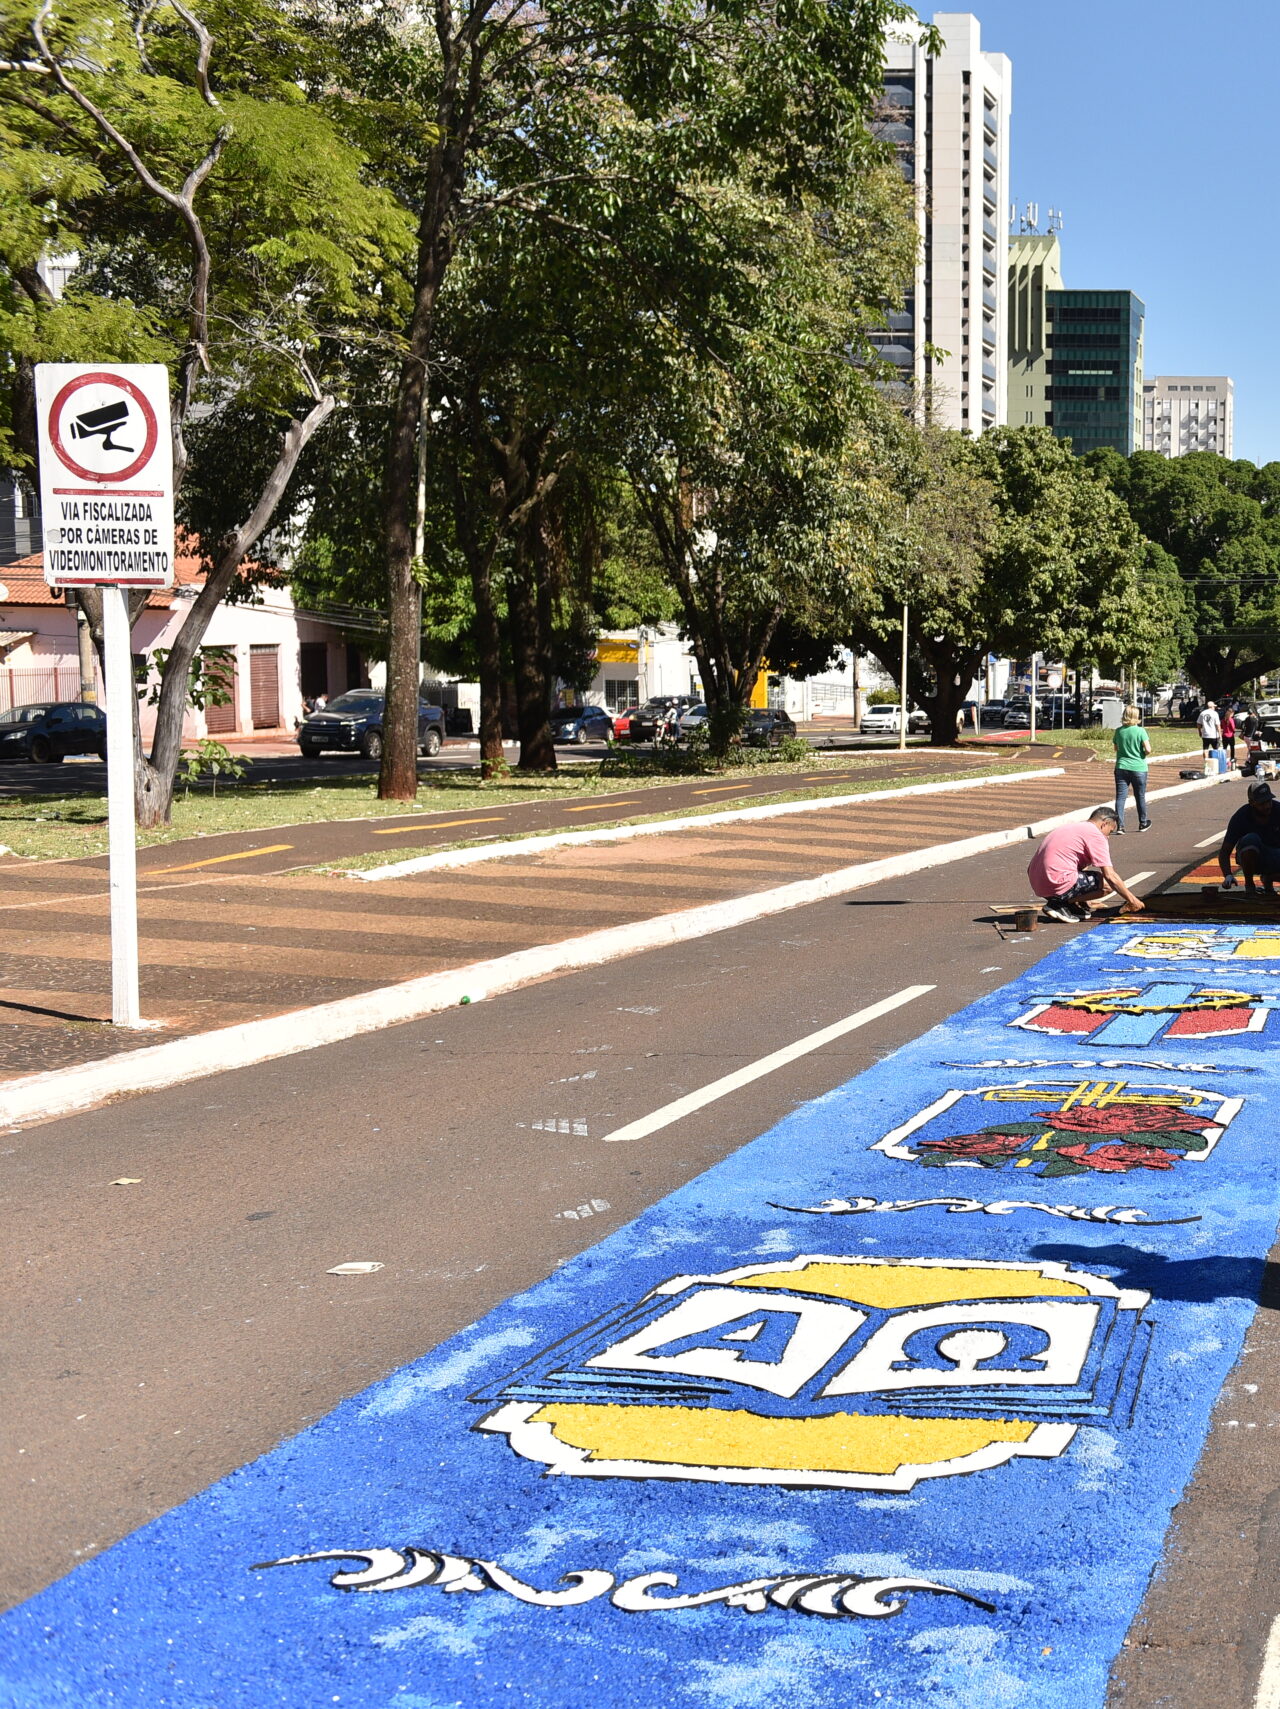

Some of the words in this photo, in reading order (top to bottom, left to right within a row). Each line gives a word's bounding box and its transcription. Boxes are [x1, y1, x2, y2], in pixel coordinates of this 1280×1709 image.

[60, 501, 80, 521] VIA
[83, 502, 153, 522] FISCALIZADA
[60, 527, 83, 544] POR
[86, 523, 140, 545] CÂMERAS
[143, 528, 158, 545] DE
[49, 549, 168, 572] VIDEOMONITORAMENTO
